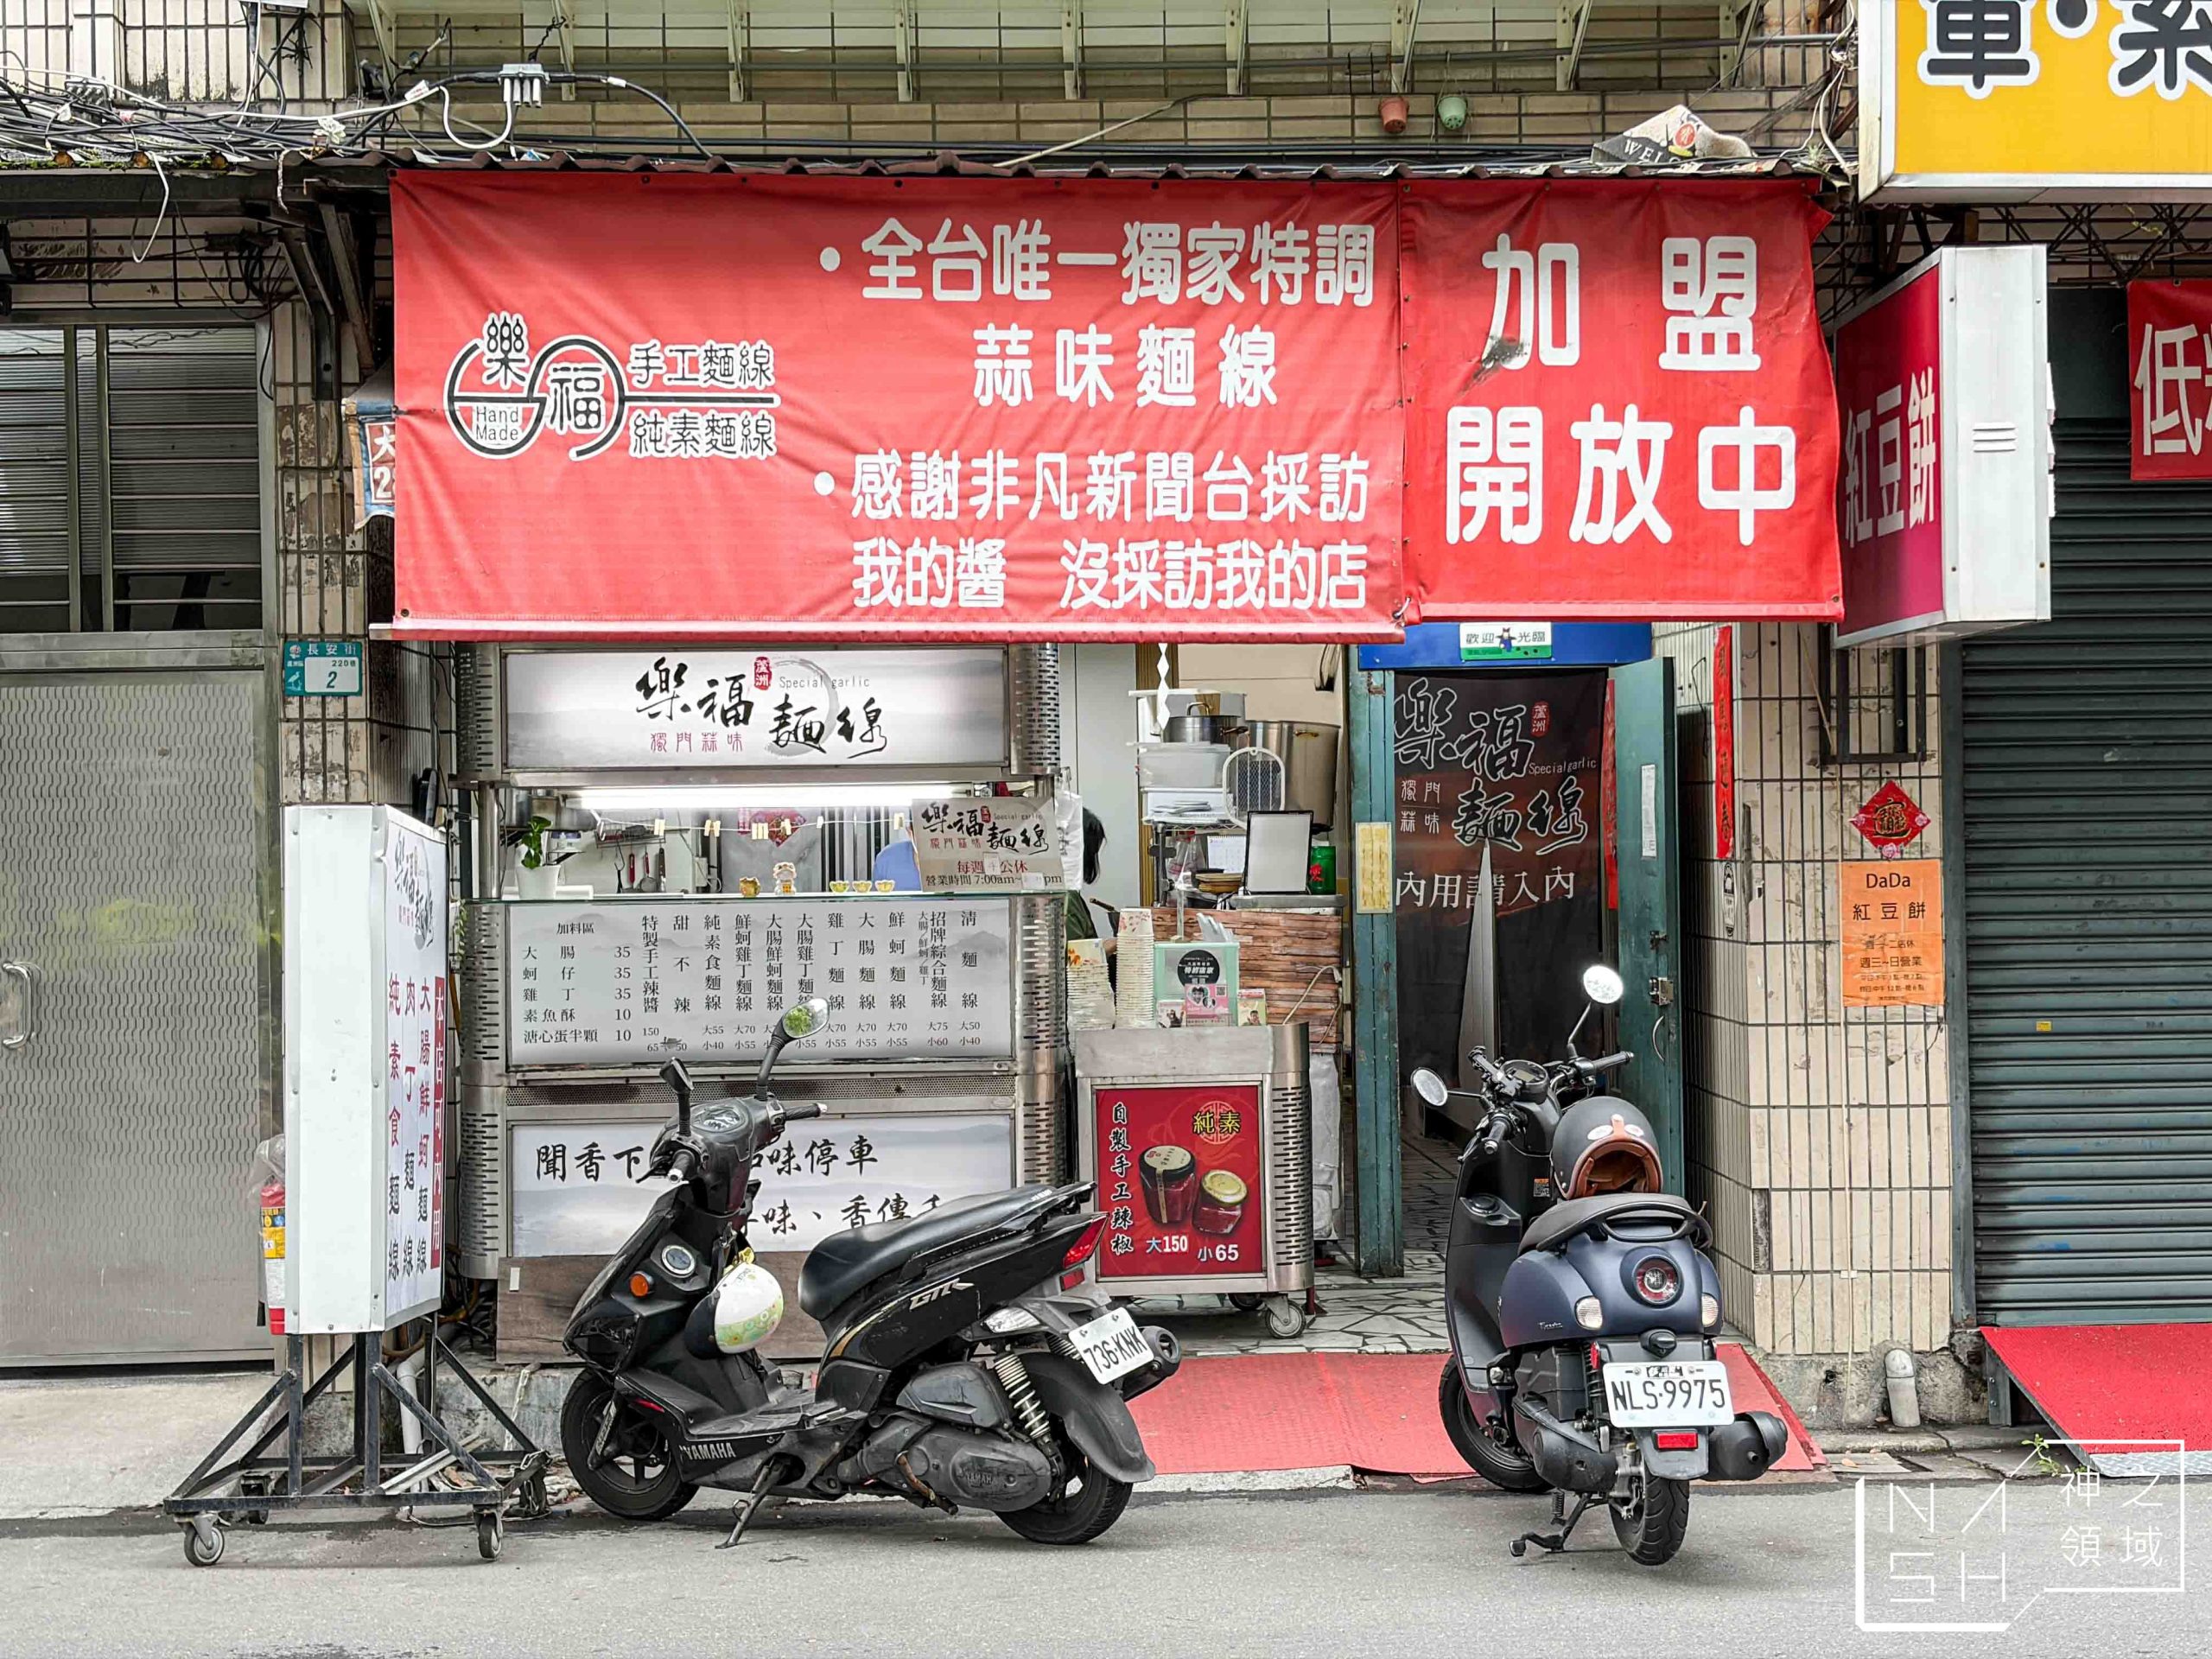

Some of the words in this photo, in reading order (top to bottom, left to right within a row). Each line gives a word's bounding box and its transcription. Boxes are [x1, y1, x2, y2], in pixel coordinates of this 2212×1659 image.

[861, 217, 1375, 307] 全台唯一獨家特調
[1481, 232, 1761, 372] 加盟
[486, 315, 603, 430] 樂福
[631, 343, 773, 386] 手工麵線
[972, 323, 1277, 409] 蒜味麵線
[476, 405, 520, 423] Hand
[476, 426, 520, 442] Made
[632, 411, 775, 458] 純素麵線
[1845, 365, 1936, 548] 紅豆餅
[1445, 403, 1796, 546] 開放中
[851, 448, 1369, 524] 感謝非凡新聞台採訪
[852, 537, 1006, 609] 我的醬
[1060, 537, 1367, 610] 沒採訪我的店
[1465, 632, 1494, 645] 歡迎
[326, 671, 338, 689] 2
[779, 676, 824, 690] Special
[831, 675, 869, 689] garlic
[636, 656, 887, 759] 樂福麵線
[651, 732, 743, 753] 獨門蒜味
[1866, 873, 1911, 889] DaDa
[1853, 901, 1926, 921] 紅豆餅
[556, 921, 595, 935] 加料區
[523, 945, 575, 960] 大腸
[613, 945, 632, 959] 35
[827, 912, 845, 1011] 雞丁麵線
[858, 912, 875, 1010] 大腸麵線
[888, 912, 906, 1010] 鮮蚵麵線
[930, 911, 947, 1008] 招牌綜合麵線
[961, 910, 979, 1009] 清麵線
[642, 914, 659, 1014] 特製手工辣醬
[672, 914, 691, 1014] 甜不辣
[703, 913, 722, 1011] 純素食麵線
[734, 913, 753, 1012] 鮮蚵雞丁麵線
[766, 913, 784, 1011] 大腸鮮蚵麵線
[523, 966, 575, 981] 蚵仔
[613, 966, 632, 980] 35
[523, 987, 575, 1002] 雞丁
[614, 988, 632, 1001] 35
[523, 1007, 576, 1023] 素魚酥
[614, 1007, 632, 1021] 10
[643, 1027, 659, 1036] 150
[702, 1025, 724, 1035] 大55
[734, 1025, 756, 1035] 大70
[825, 1023, 847, 1033] 大70
[856, 1023, 876, 1033] 大70
[887, 1022, 907, 1032] 大70
[927, 1021, 949, 1031] 大75
[959, 1020, 981, 1031] 大50
[614, 1028, 632, 1042] 10
[795, 1039, 817, 1049] 小55
[825, 1039, 847, 1048] 小55
[855, 1038, 877, 1048] 小55
[887, 1038, 907, 1047] 小55
[927, 1037, 949, 1047] 小60
[959, 1036, 981, 1046] 小40
[647, 1043, 659, 1052] 65
[676, 1043, 688, 1052] 50
[702, 1040, 724, 1051] 小40
[734, 1040, 756, 1050] 小55
[388, 972, 401, 1281] 純素食麵線
[403, 976, 416, 1277] 肉丁麵線
[416, 977, 431, 1274] 大腸鮮蚵麵線
[1193, 1111, 1241, 1134] 純素
[1109, 1102, 1135, 1255] 自製手工辣椒
[1146, 1235, 1188, 1254] 大150
[1198, 1244, 1239, 1262] 小65
[684, 1442, 736, 1460] YAMAHA
